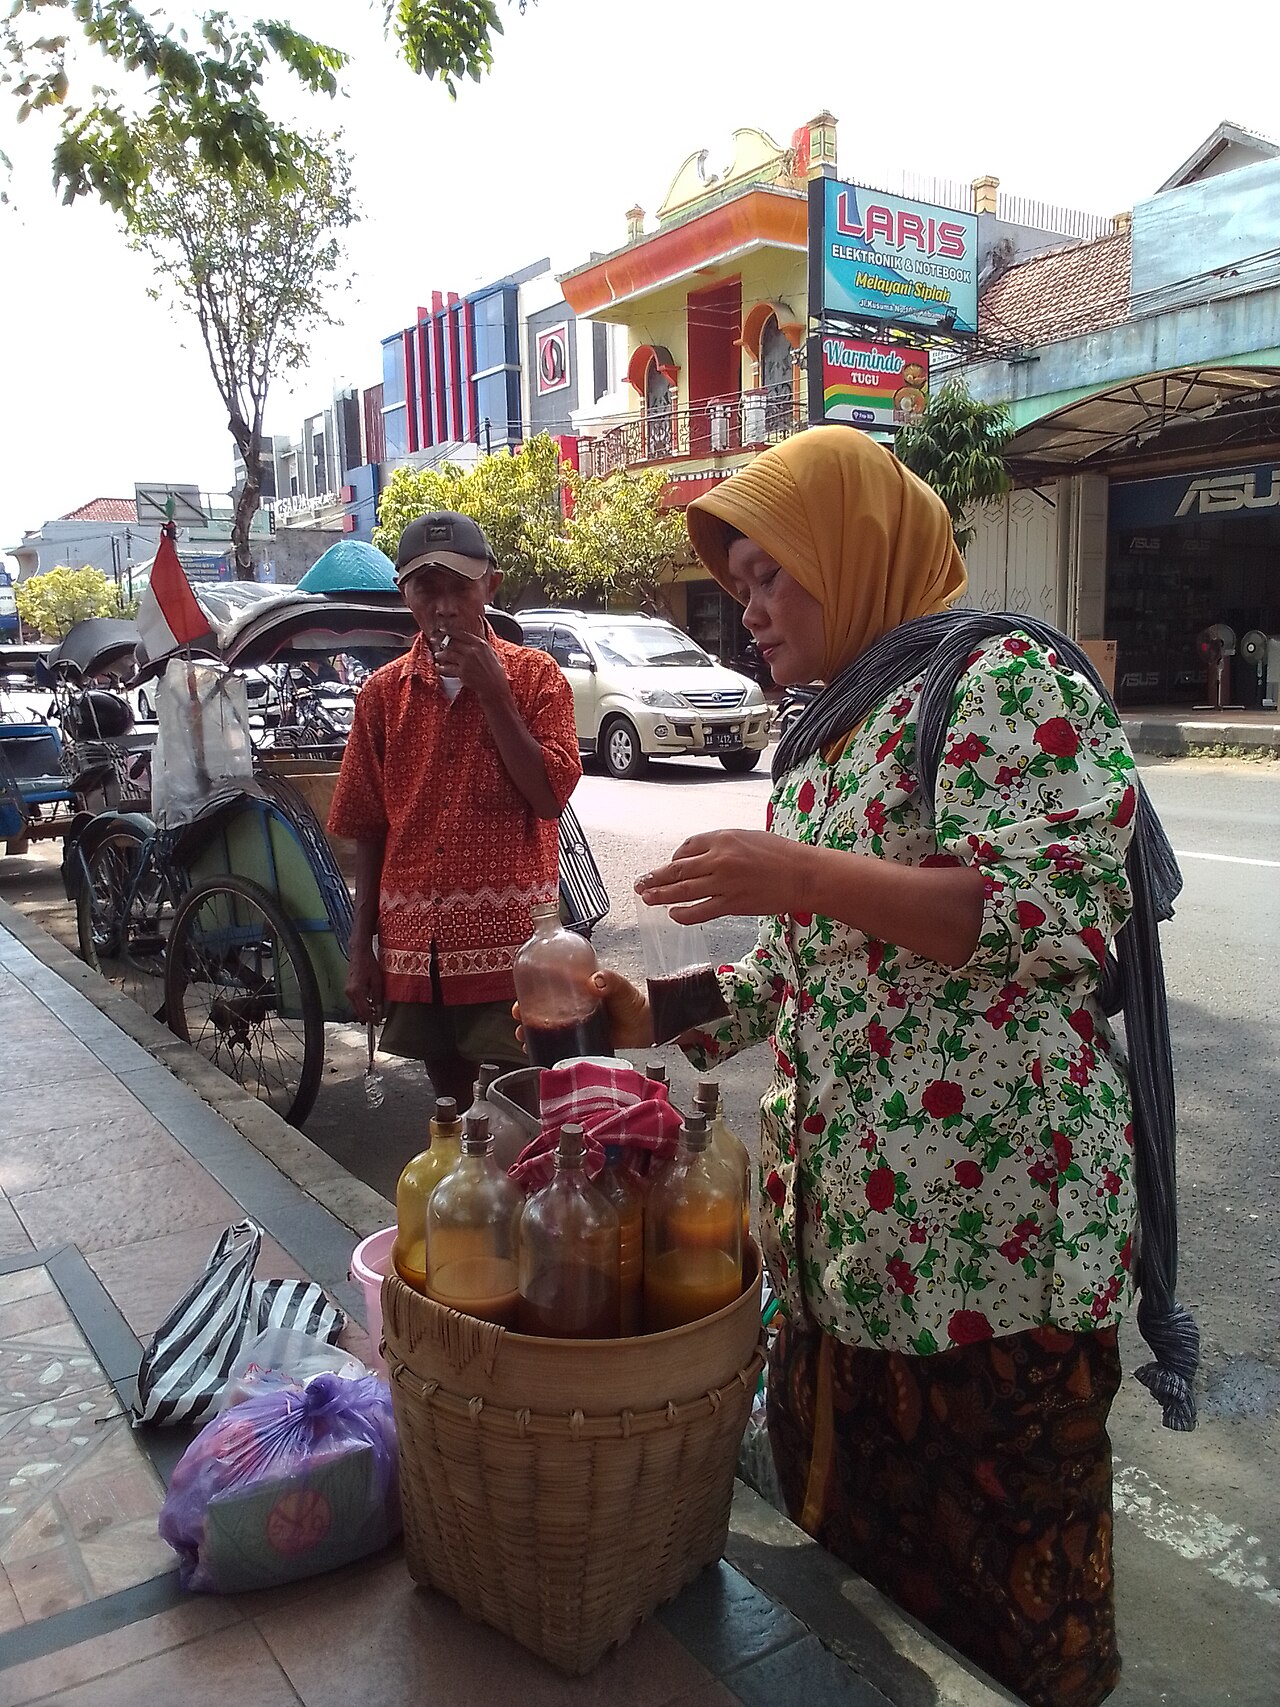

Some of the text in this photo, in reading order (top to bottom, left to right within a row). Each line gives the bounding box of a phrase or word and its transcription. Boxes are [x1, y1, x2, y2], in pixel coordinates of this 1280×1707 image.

[837, 191, 967, 260] LARIS
[832, 243, 972, 284] ELEKTRONIK & NOTEBOOK
[855, 271, 951, 303] Melayani Siplah
[823, 339, 905, 374] Warmindo
[851, 372, 879, 386] TUGU
[1174, 469, 1280, 517] ASU
[1129, 536, 1160, 549] ASUS
[1120, 671, 1159, 687] ASUS
